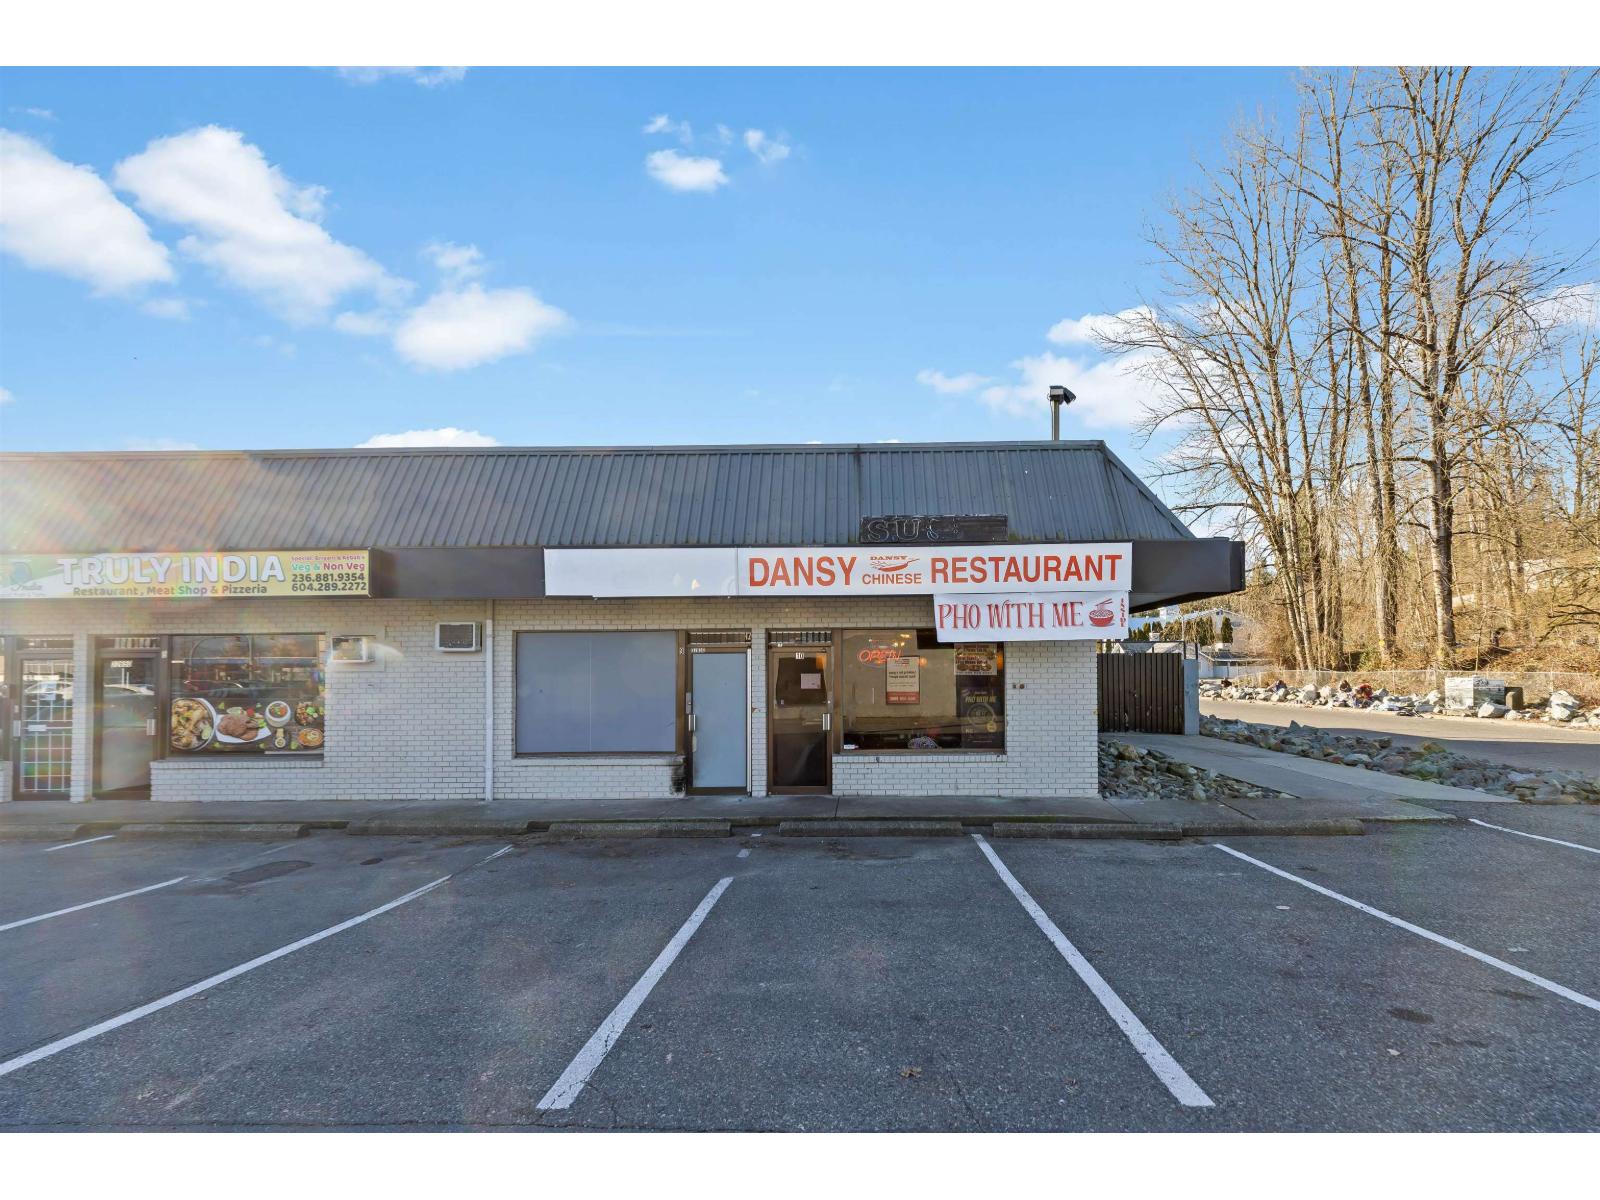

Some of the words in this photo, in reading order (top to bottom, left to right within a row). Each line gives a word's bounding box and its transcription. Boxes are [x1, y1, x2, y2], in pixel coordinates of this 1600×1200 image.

[57, 556, 172, 585] TRULY
[182, 555, 286, 583] INDIA
[291, 563, 311, 573] Veg
[313, 562, 321, 570] &
[323, 562, 344, 570] Non
[346, 562, 365, 572] Veg
[749, 556, 857, 587] DANSY
[931, 554, 1123, 584] RESTAURANT
[291, 572, 365, 583] 236.881.9354
[862, 573, 922, 585] CHINESE
[147, 586, 176, 595] Meat
[178, 585, 208, 595] Shop
[210, 585, 218, 594] &
[222, 583, 268, 594] Pizzeria
[291, 582, 367, 592] 604.289.2272
[938, 603, 982, 630] PHO
[986, 600, 1045, 630] WITH
[1052, 601, 1084, 628] ME
